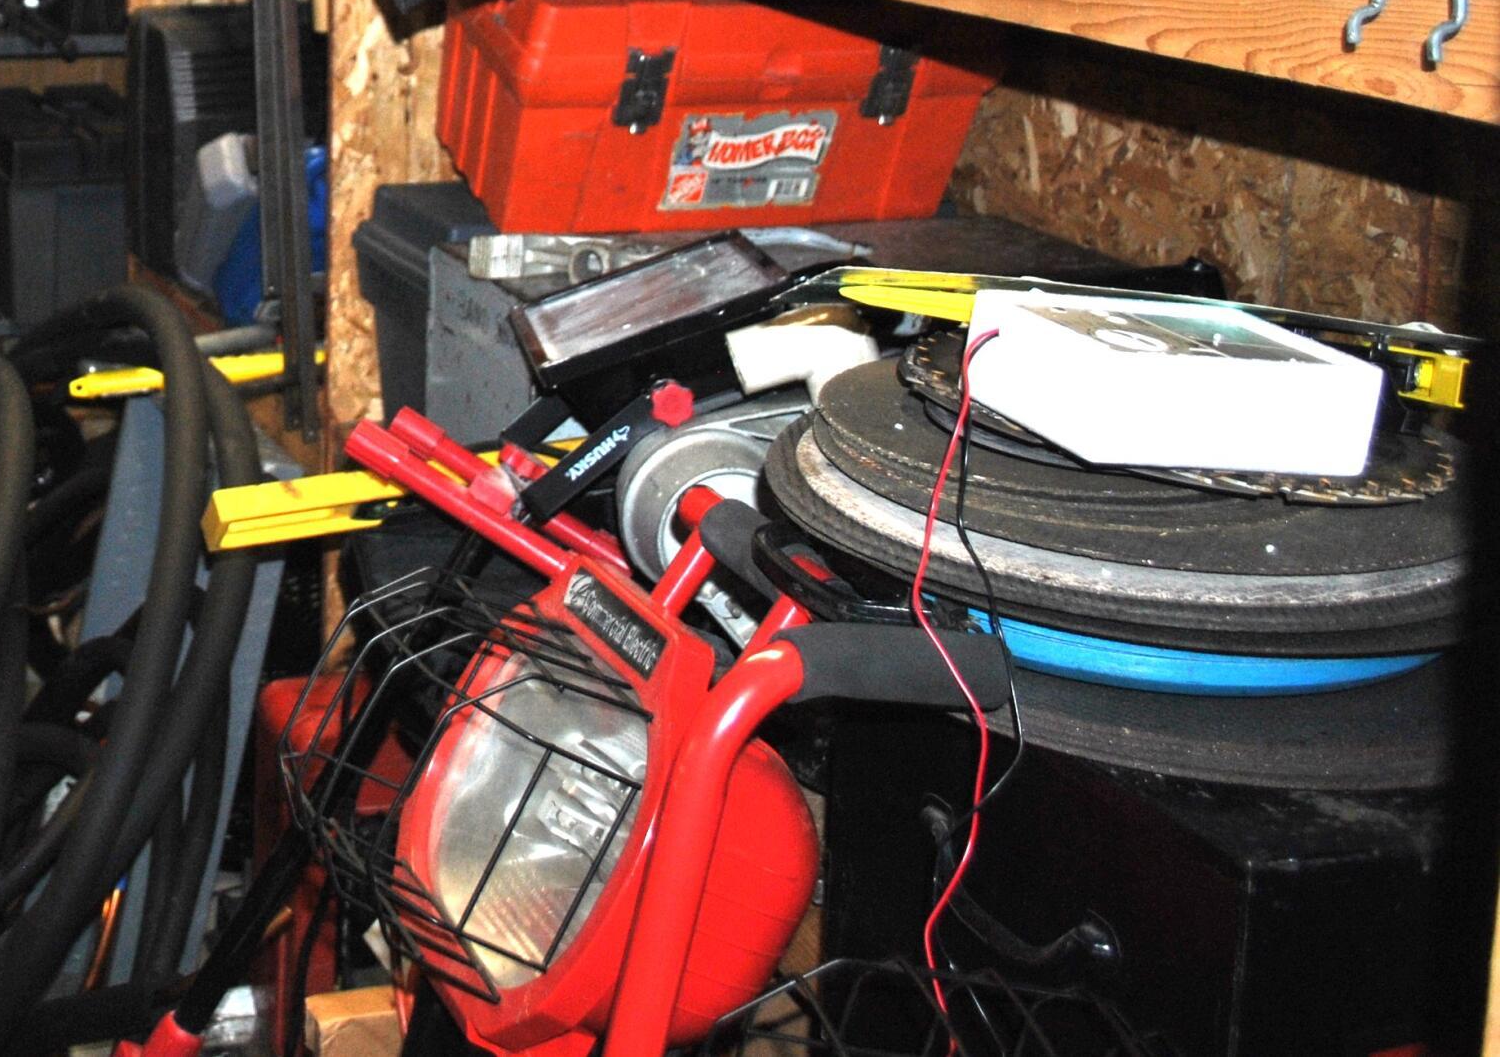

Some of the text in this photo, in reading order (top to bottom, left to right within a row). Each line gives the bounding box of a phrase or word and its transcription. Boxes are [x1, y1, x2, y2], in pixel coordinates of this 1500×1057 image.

[567, 436, 617, 482] HUSKY
[581, 590, 658, 672] Commercial Electric
